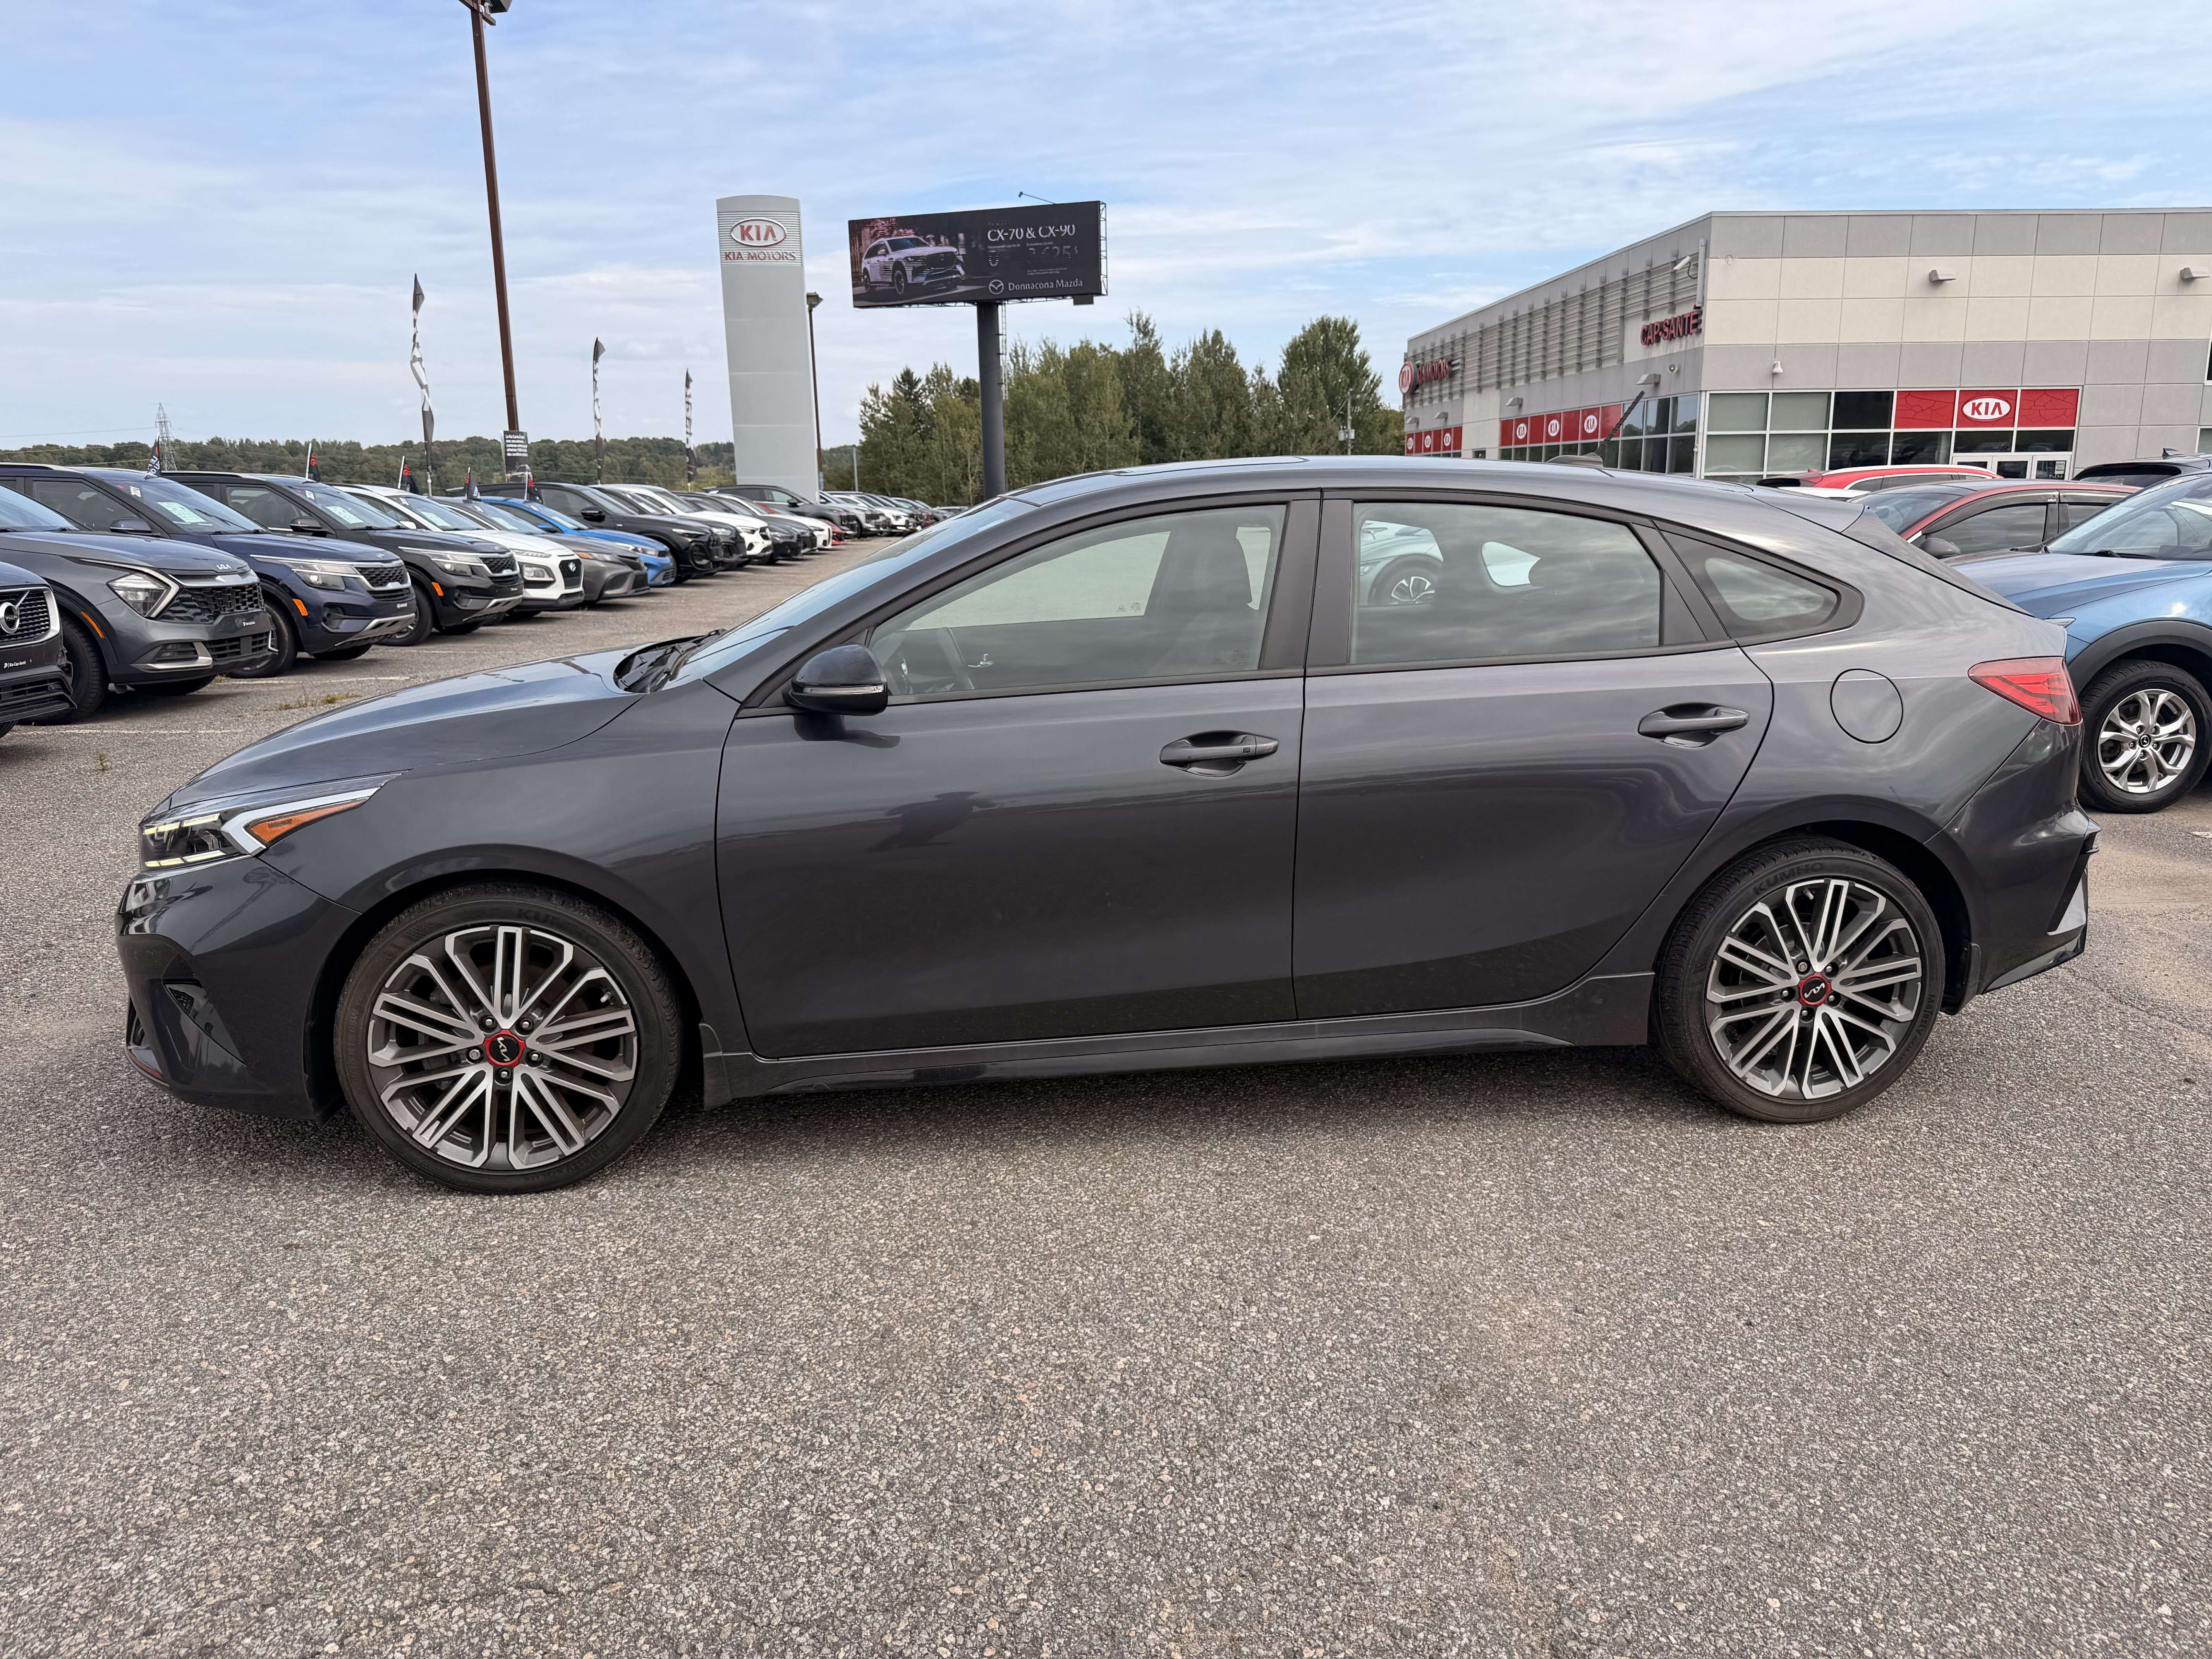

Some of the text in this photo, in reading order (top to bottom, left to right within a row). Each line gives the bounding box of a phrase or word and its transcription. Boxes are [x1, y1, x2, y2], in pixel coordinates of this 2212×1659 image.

[740, 225, 778, 241] KIA
[988, 224, 1075, 241] CX-70 & CX-90
[725, 251, 796, 260] KIA MOTORS
[1008, 278, 1083, 291] Donnacona Mazda
[1971, 402, 2002, 416] KIA
[1586, 418, 1595, 430] KIA
